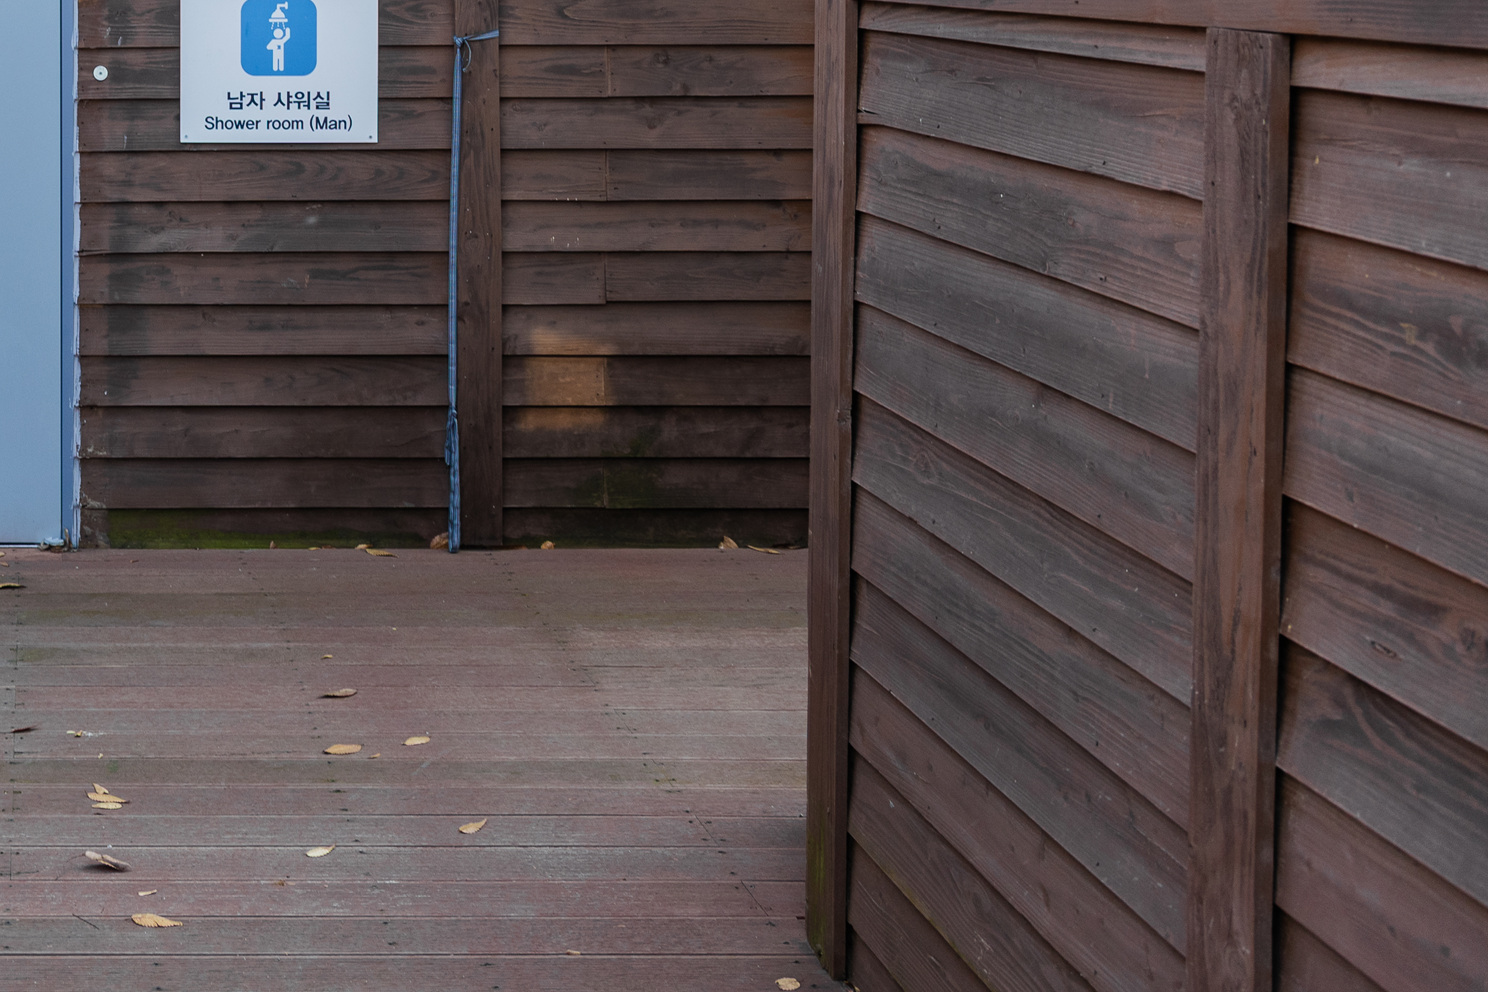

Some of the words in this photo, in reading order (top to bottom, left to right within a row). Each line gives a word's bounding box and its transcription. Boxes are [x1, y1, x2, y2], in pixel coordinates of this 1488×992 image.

[227, 91, 266, 111] 남자
[273, 91, 331, 111] 샤워실
[204, 115, 261, 130] Shower
[266, 119, 304, 130] room
[309, 114, 353, 132] (Man)
